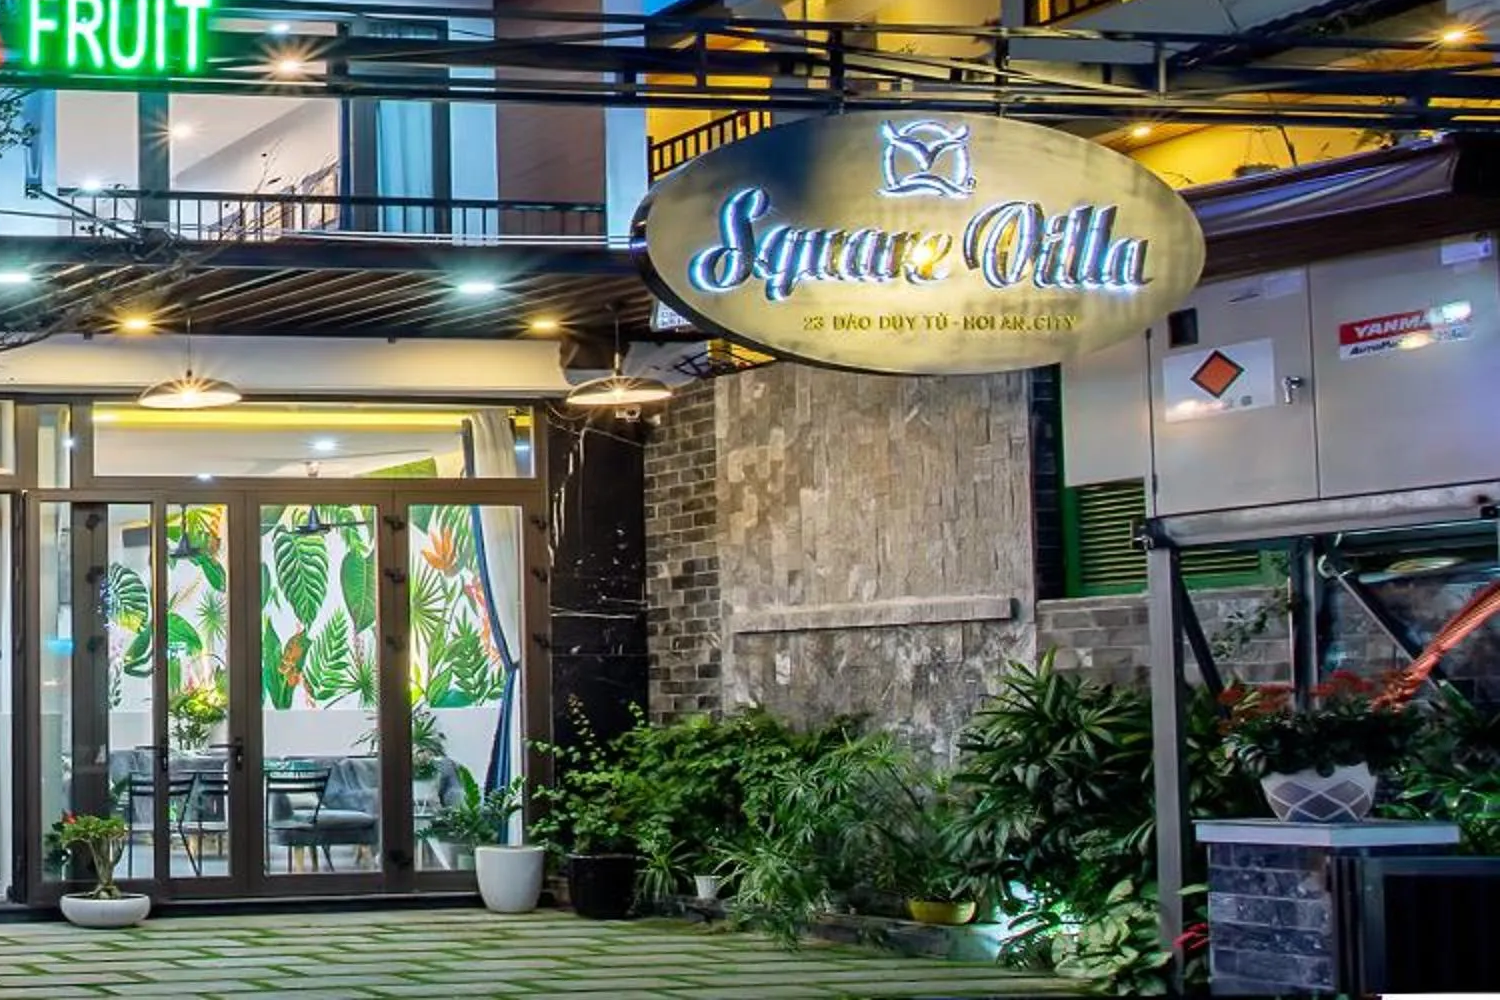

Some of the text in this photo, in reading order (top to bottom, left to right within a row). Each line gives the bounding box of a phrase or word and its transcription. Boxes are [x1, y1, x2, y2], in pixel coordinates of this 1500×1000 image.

[688, 187, 1153, 301] Square Villa
[803, 315, 824, 331] 23
[879, 315, 915, 331] DUY
